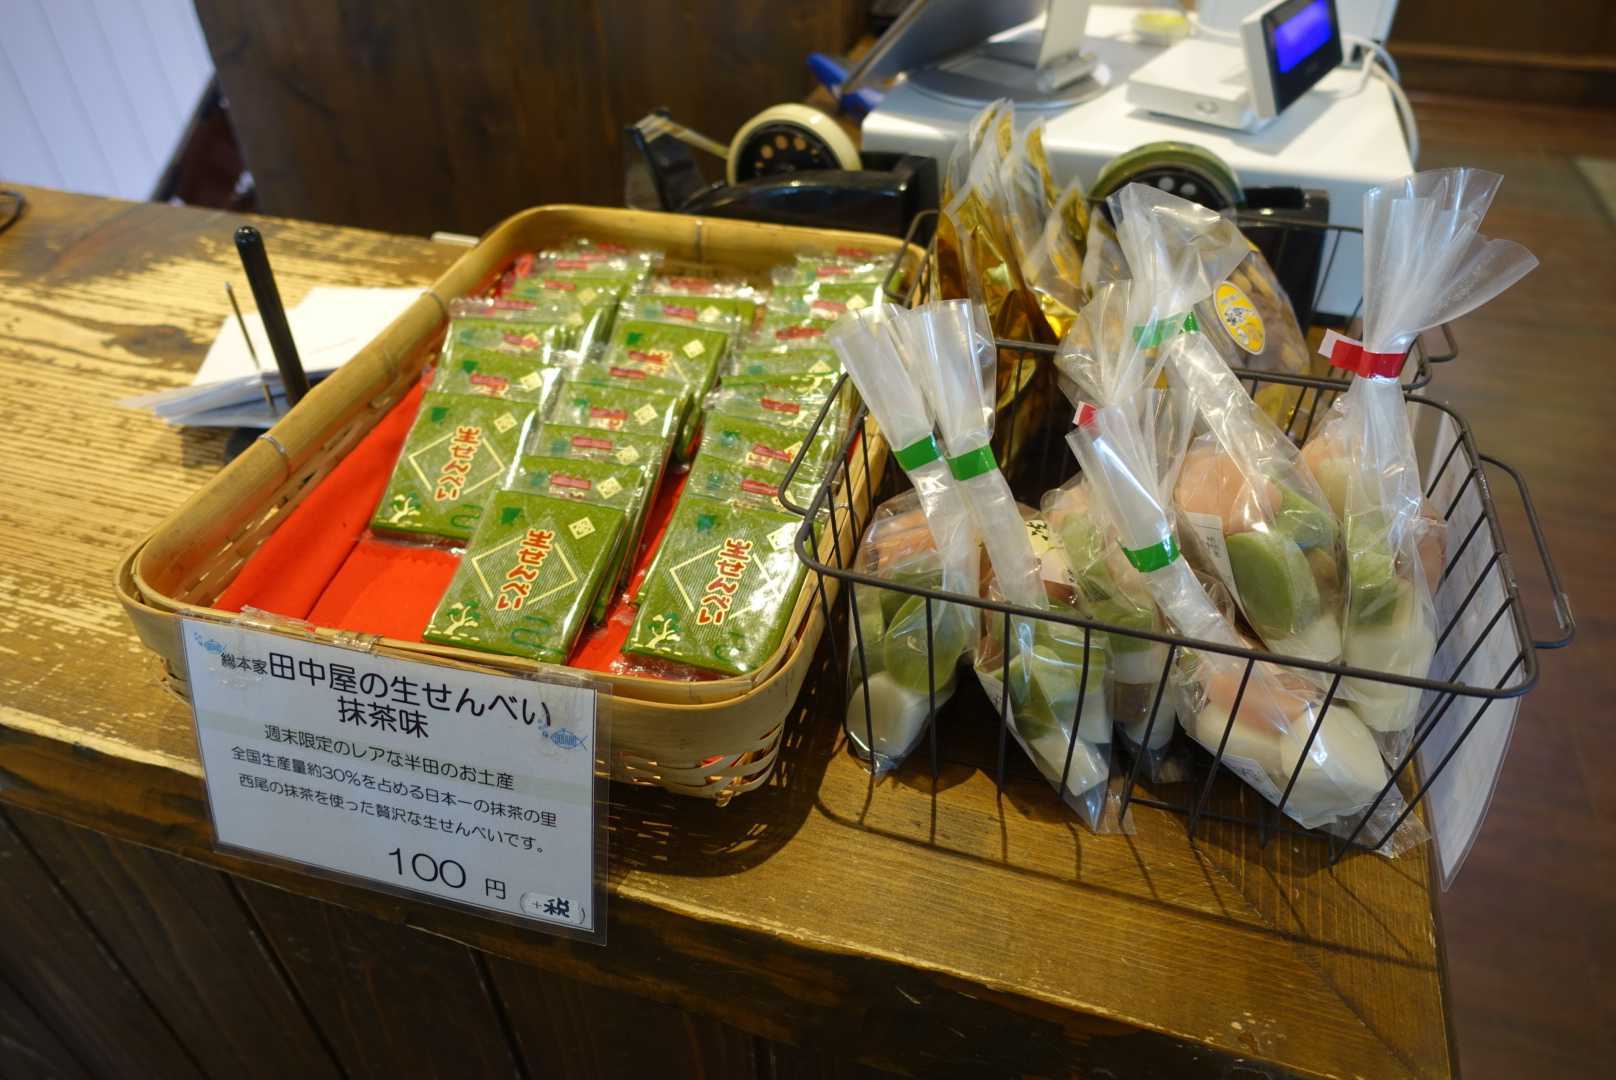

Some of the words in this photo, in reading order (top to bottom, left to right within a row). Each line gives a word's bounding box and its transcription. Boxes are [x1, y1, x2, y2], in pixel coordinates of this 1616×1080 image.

[435, 425, 482, 501] 生せんべい
[496, 528, 556, 611] 生せんべい
[697, 537, 753, 624] 生せんべい
[337, 695, 429, 739] 抹茶味
[231, 745, 558, 828] 全国生産量約30%を占める日本一の抹茶の里
[264, 723, 515, 791] 週末限定のレアな半田のお土産
[238, 772, 544, 854] 西尾の抹茶を使った贅沢な生せんべいです。
[388, 847, 467, 889] 100
[484, 877, 507, 901] 円
